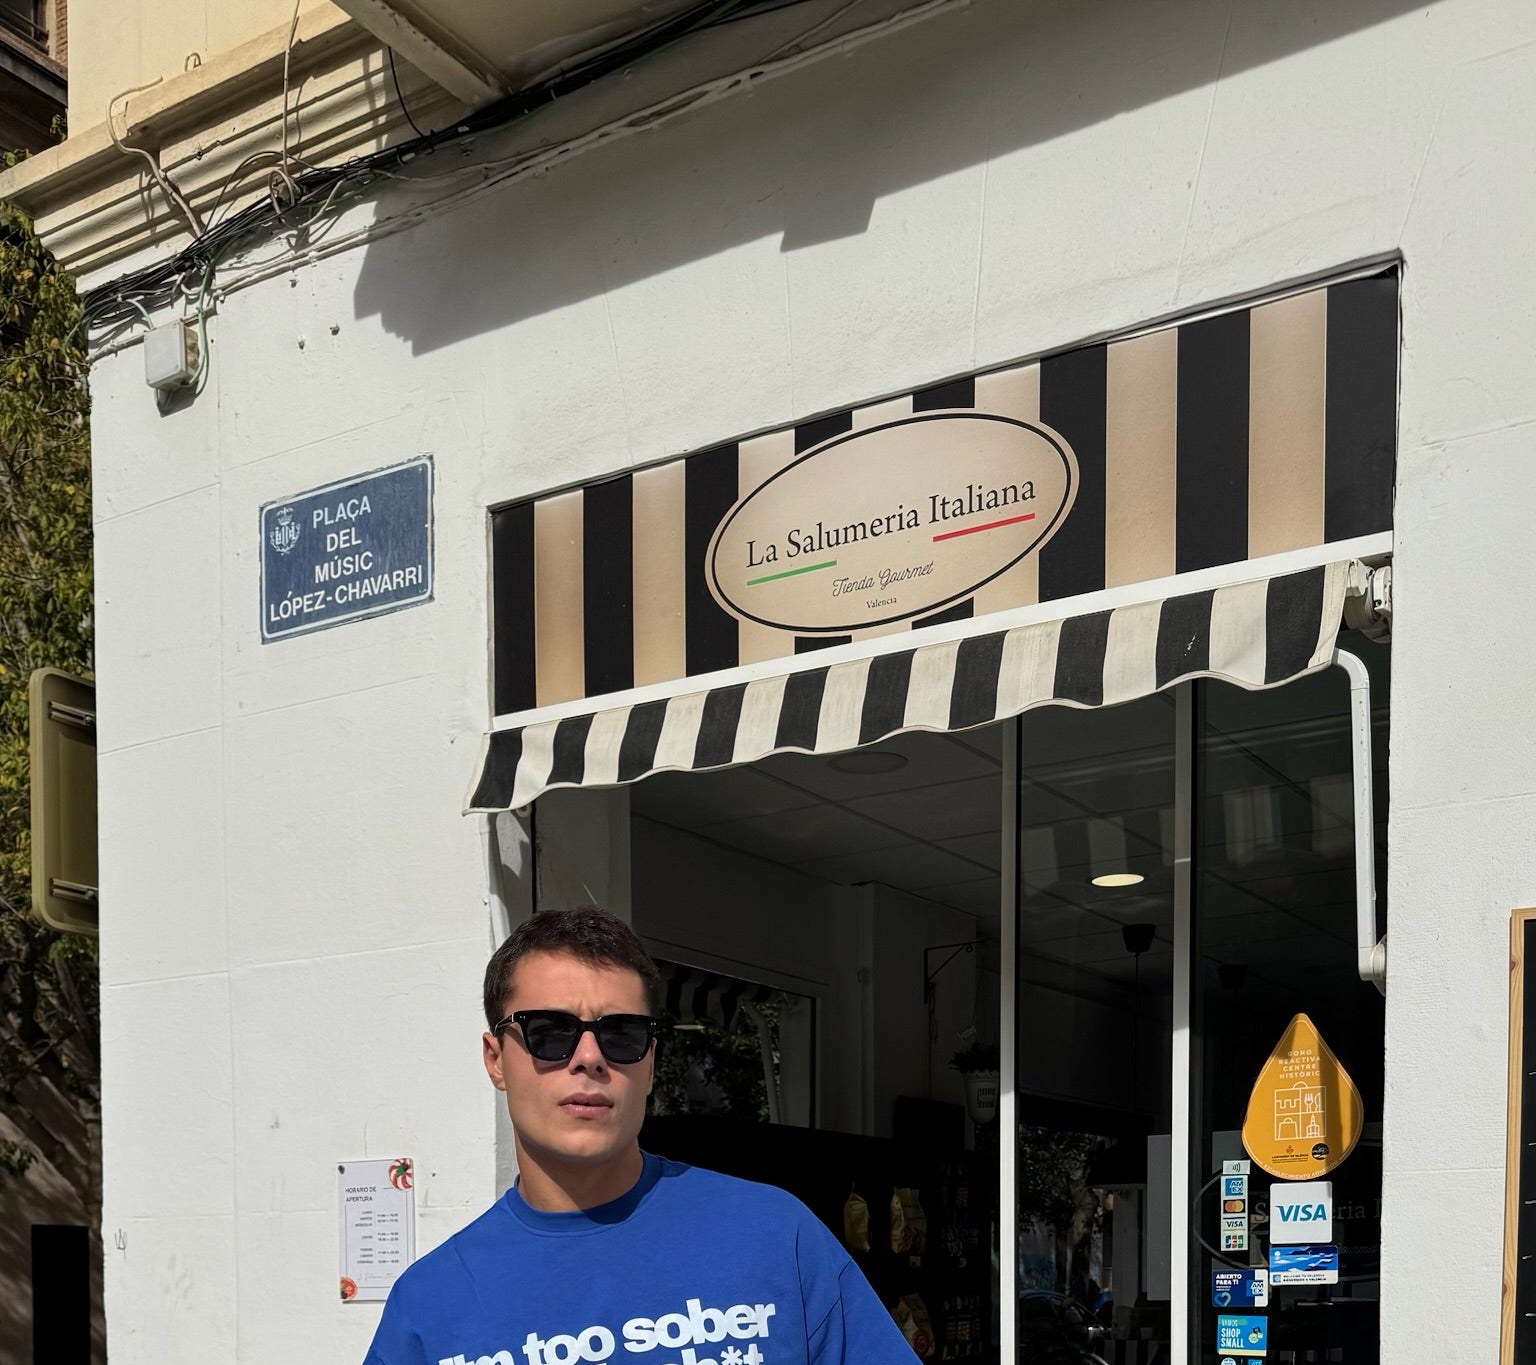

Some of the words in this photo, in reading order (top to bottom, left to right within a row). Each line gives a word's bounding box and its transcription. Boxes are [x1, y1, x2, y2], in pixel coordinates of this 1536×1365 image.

[312, 495, 372, 529] PLAÇA
[746, 540, 778, 568] La
[786, 504, 920, 558] Salumeria
[928, 480, 1036, 524] Italiana
[326, 527, 362, 553] DEL
[314, 551, 374, 584] MÚSIC
[832, 574, 876, 597] Tienda
[878, 560, 934, 591] Gourmet
[270, 565, 423, 622] LÓPEZ-CHAVARRI
[866, 597, 897, 609] Valencia
[1278, 1055, 1321, 1065] REACTIVA
[1282, 1063, 1317, 1072] CENTRE
[1275, 1203, 1327, 1222] VISA
[1226, 1220, 1244, 1228] VISA
[622, 1297, 776, 1353] sober
[1221, 1328, 1241, 1337] SHOP
[1221, 1338, 1245, 1348] SMALL
